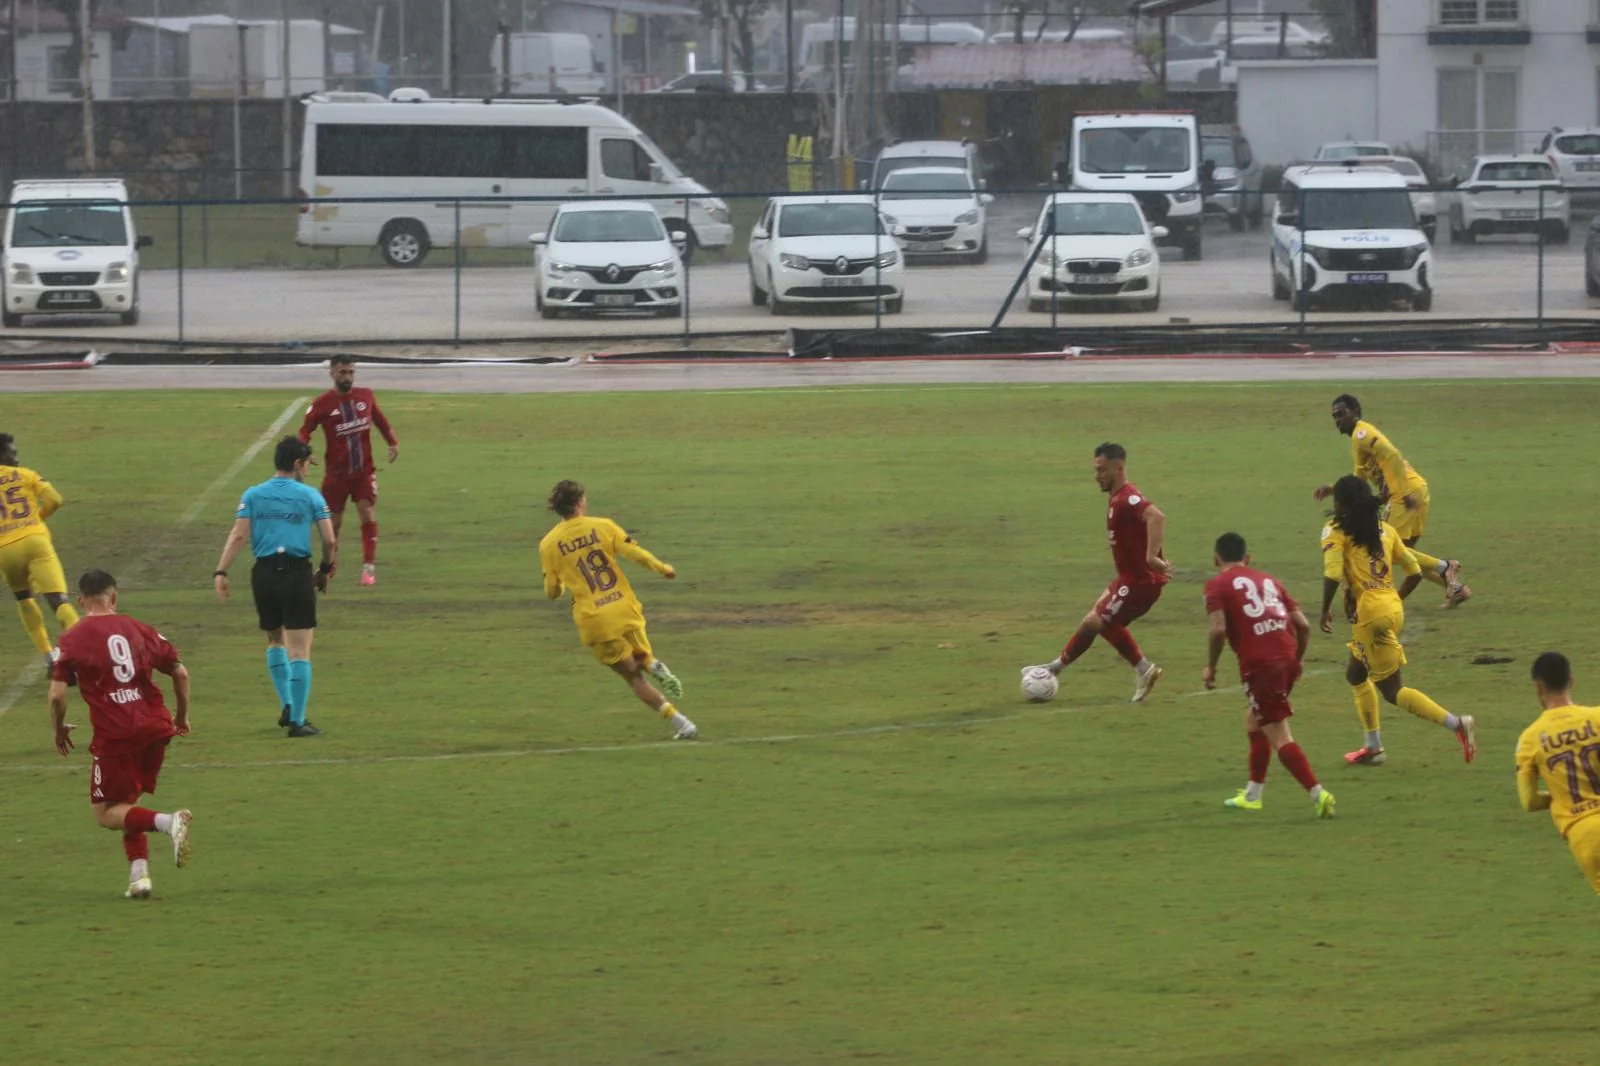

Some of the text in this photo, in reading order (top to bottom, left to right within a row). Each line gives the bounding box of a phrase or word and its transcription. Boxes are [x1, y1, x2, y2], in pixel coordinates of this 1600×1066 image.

[558, 528, 600, 556] fuzul
[576, 549, 618, 595] 18
[1232, 576, 1287, 618] 34
[107, 634, 136, 683] 9
[109, 688, 142, 704] TÜRK
